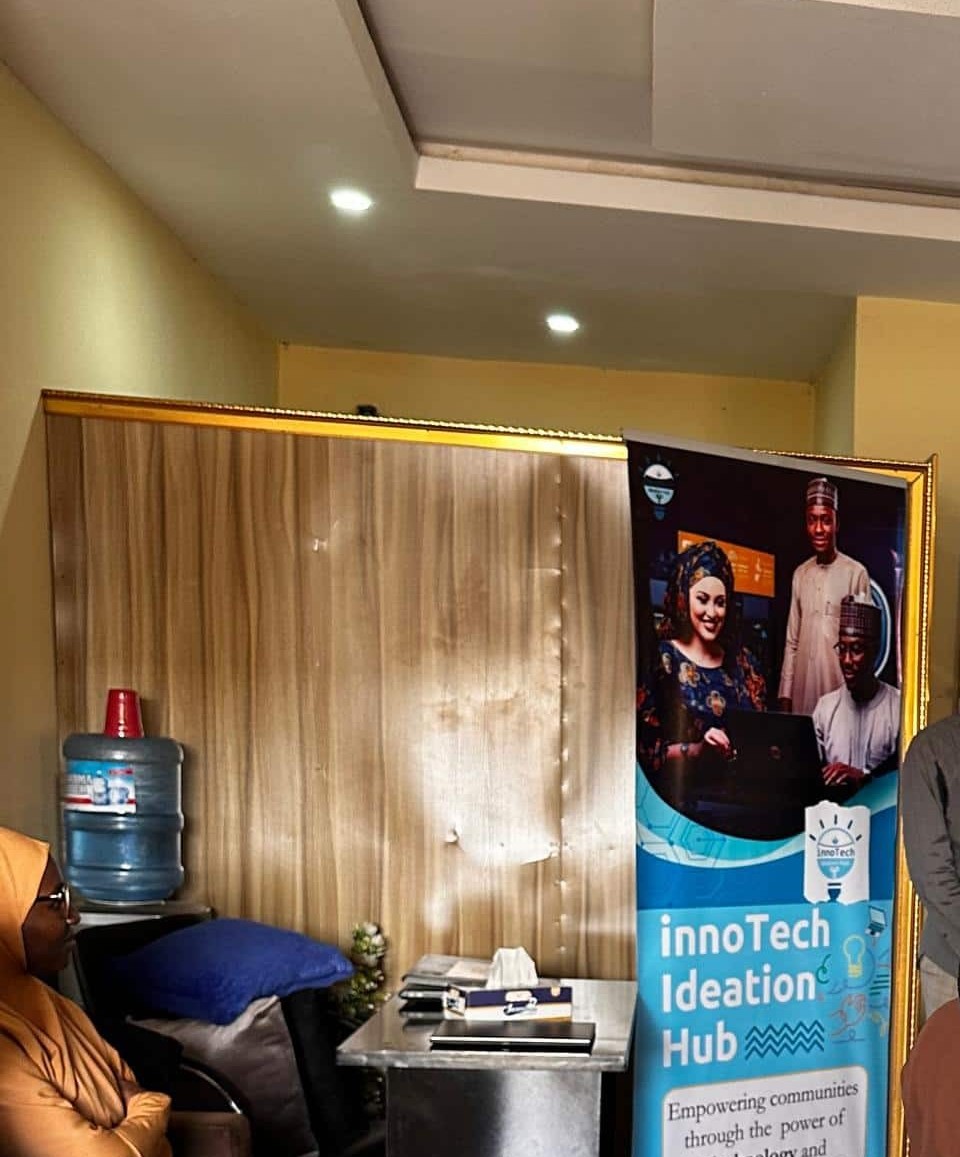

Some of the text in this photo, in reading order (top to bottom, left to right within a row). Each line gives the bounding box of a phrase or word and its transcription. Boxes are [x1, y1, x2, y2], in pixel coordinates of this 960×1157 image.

[661, 908, 830, 957] innoTech
[662, 963, 816, 1013] Ideation
[663, 1020, 738, 1068] Hub
[668, 1080, 859, 1123] Empowering communities
[684, 1107, 846, 1149] through the power of
[801, 1138, 827, 1157] and
